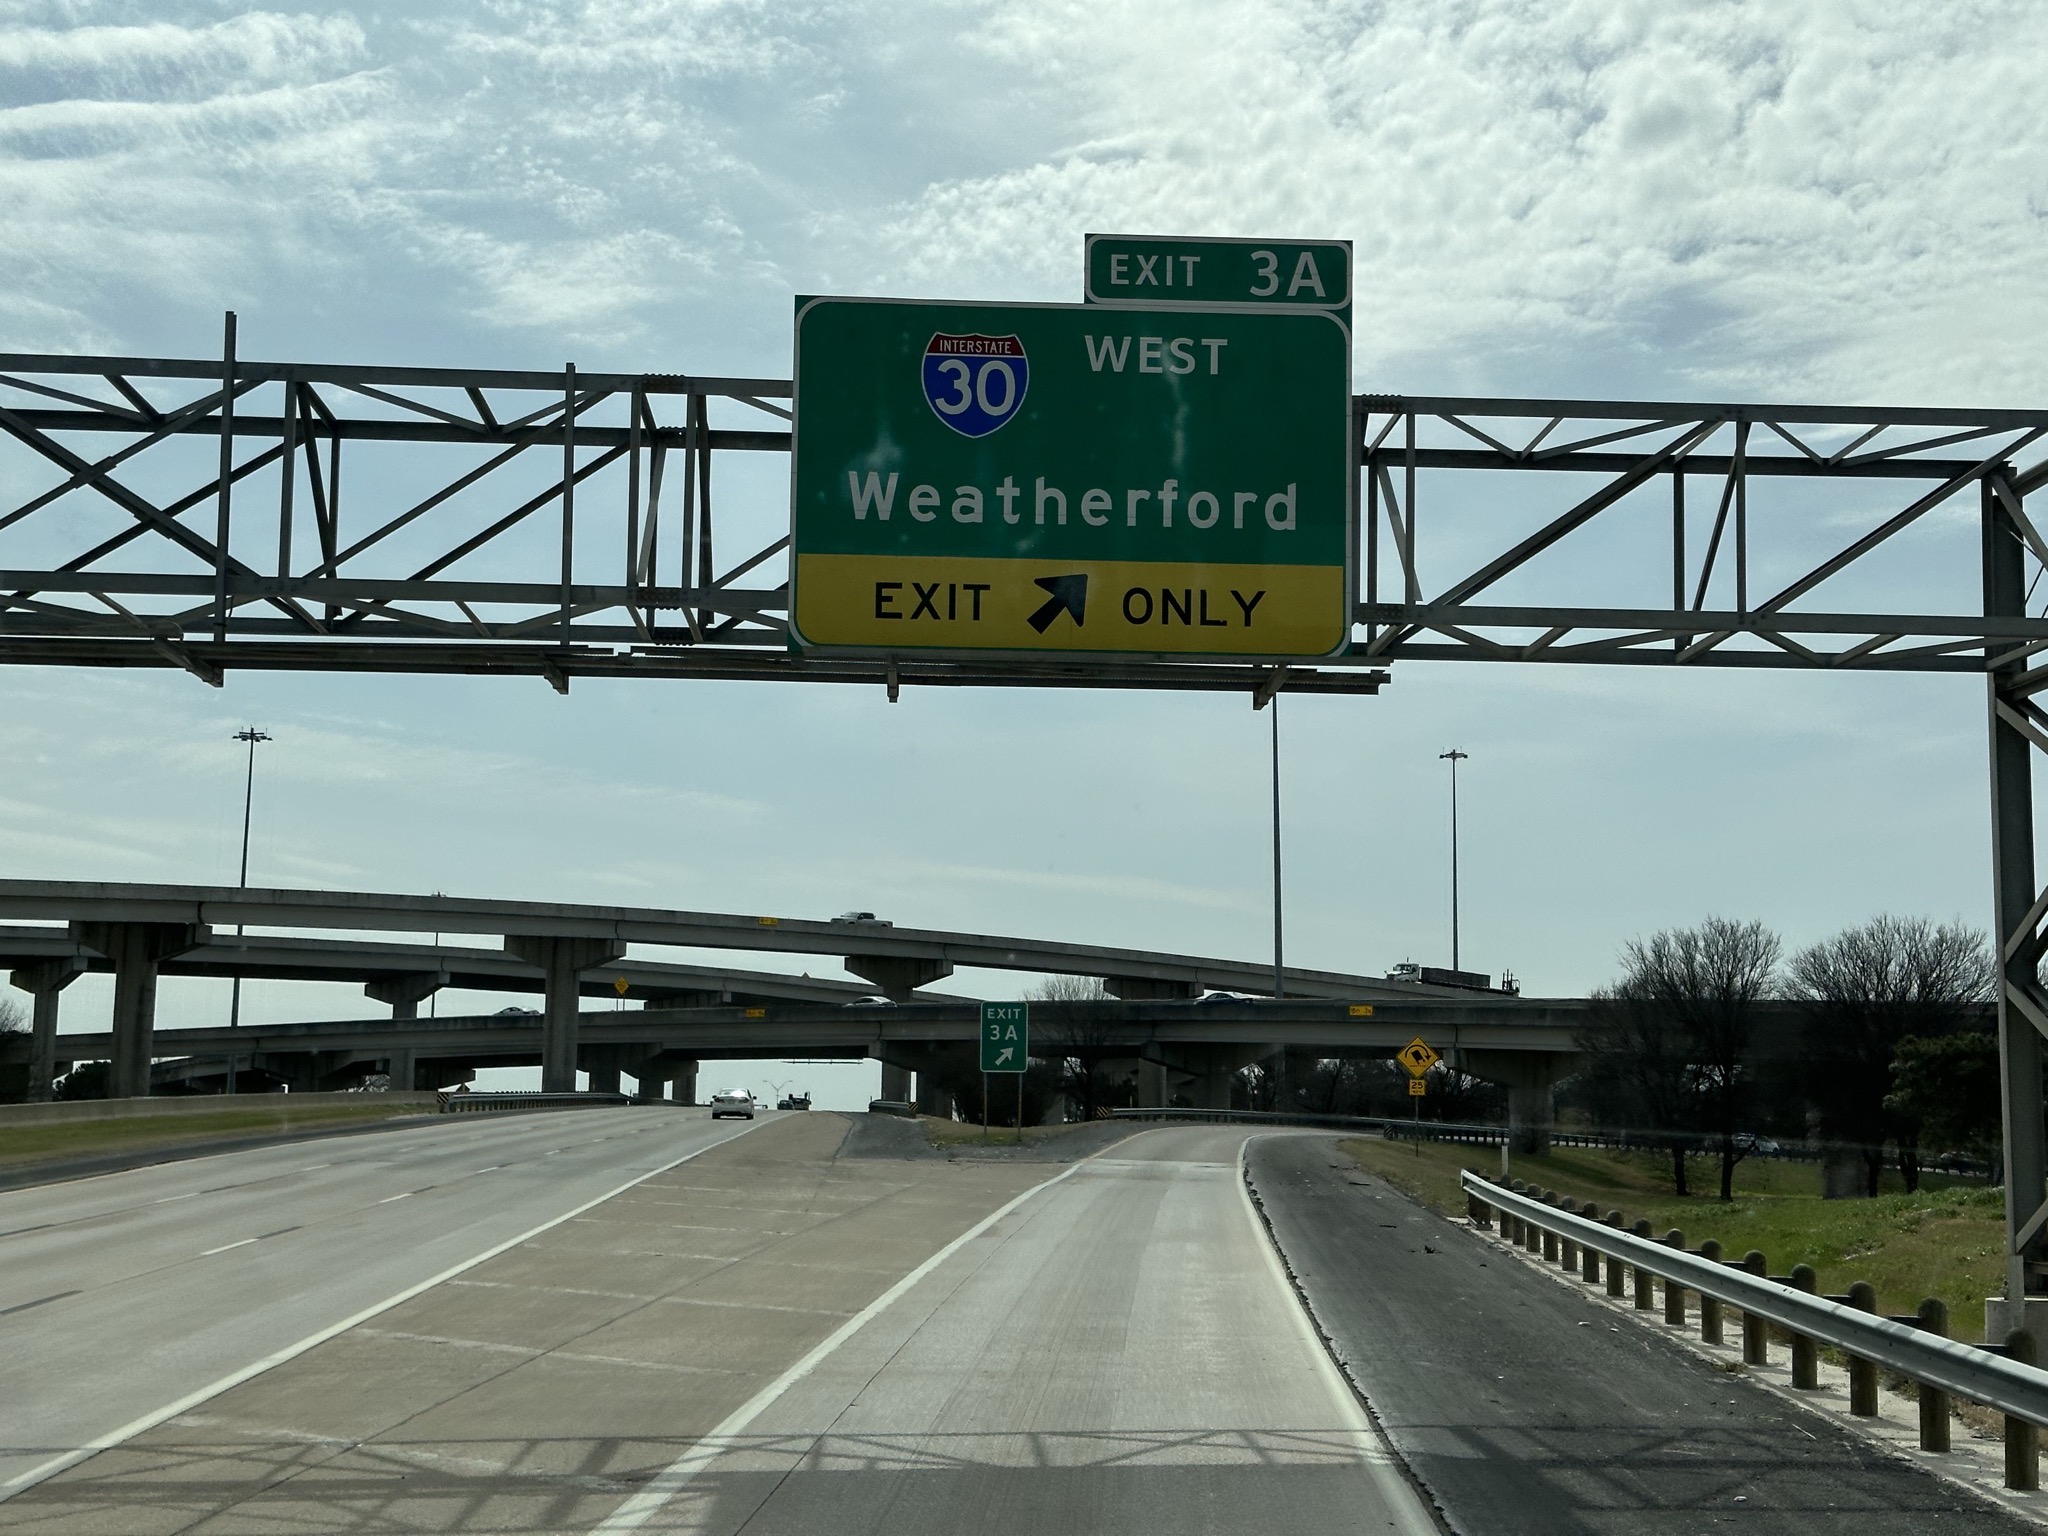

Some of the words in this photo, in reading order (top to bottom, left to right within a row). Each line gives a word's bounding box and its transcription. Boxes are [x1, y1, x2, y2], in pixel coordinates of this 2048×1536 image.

[1110, 254, 1200, 287] EXIT
[1249, 251, 1326, 297] 3A
[939, 339, 1012, 354] INTERSTATE
[1084, 335, 1228, 375] WEST
[935, 359, 1016, 416] 30
[848, 470, 1297, 531] Weatherford
[874, 581, 991, 621] EXIT
[1122, 587, 1267, 628] ONLY
[987, 1008, 1020, 1019] EXIT
[990, 1025, 1018, 1040] 3A
[1411, 1081, 1424, 1089] 25
